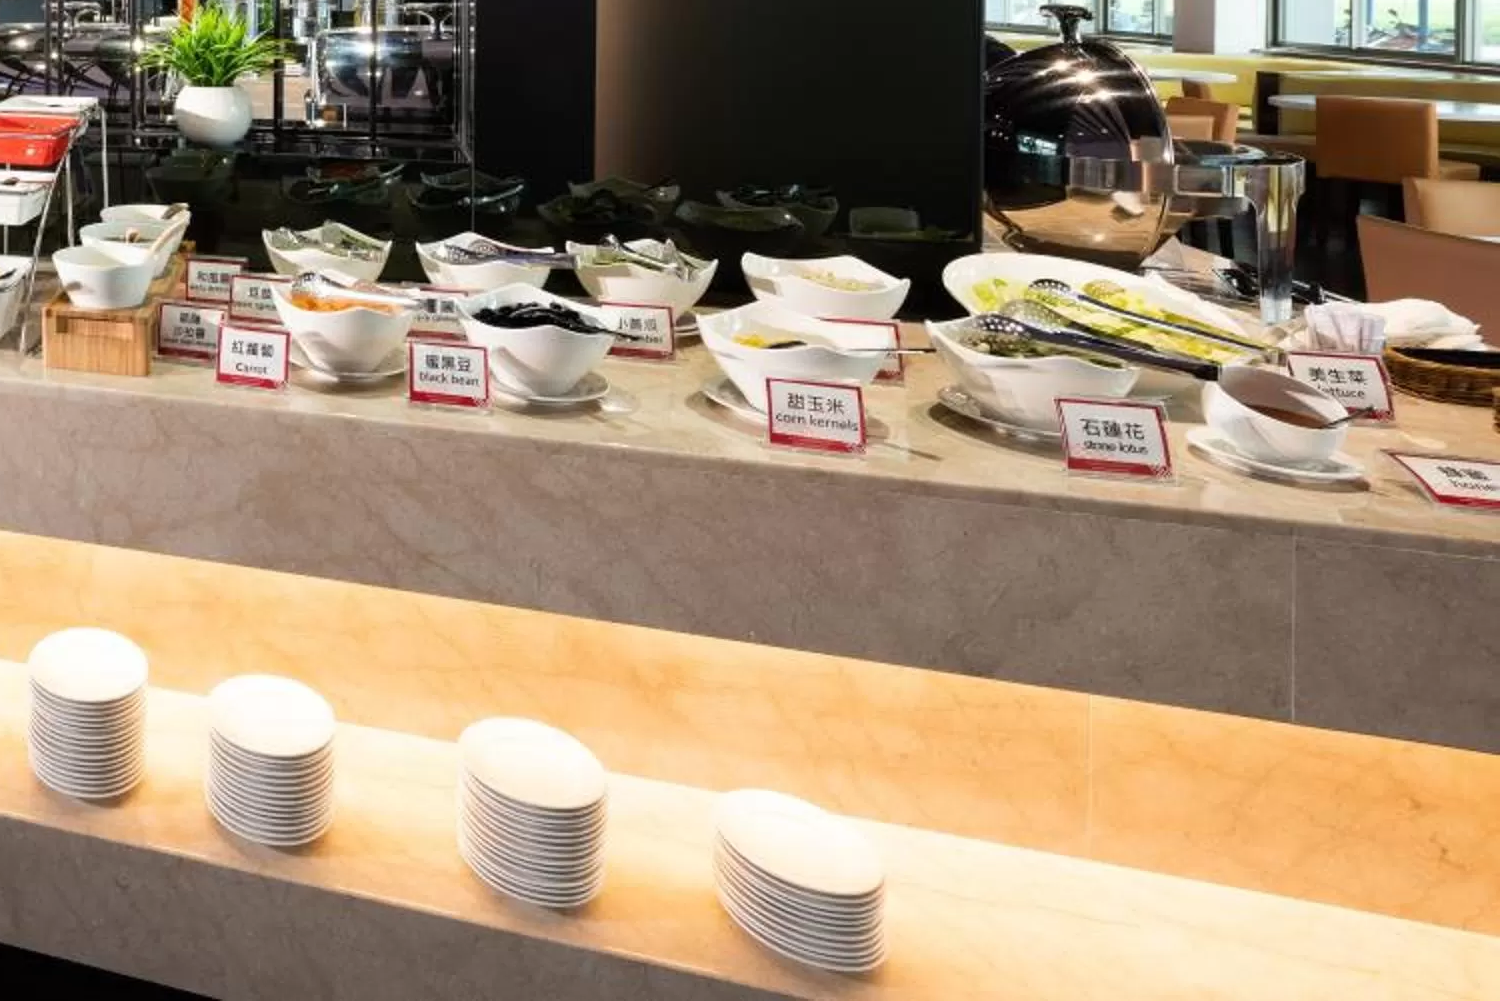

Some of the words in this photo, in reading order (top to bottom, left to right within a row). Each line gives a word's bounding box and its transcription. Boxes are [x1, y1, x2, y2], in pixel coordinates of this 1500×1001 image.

[231, 340, 275, 358] 紅蘿蔔
[235, 362, 268, 374] Carrot
[419, 371, 448, 384] black
[787, 392, 845, 414] 甜玉米
[775, 412, 806, 424] corn
[809, 415, 858, 431] kernels
[1080, 418, 1145, 440] 石蓮花
